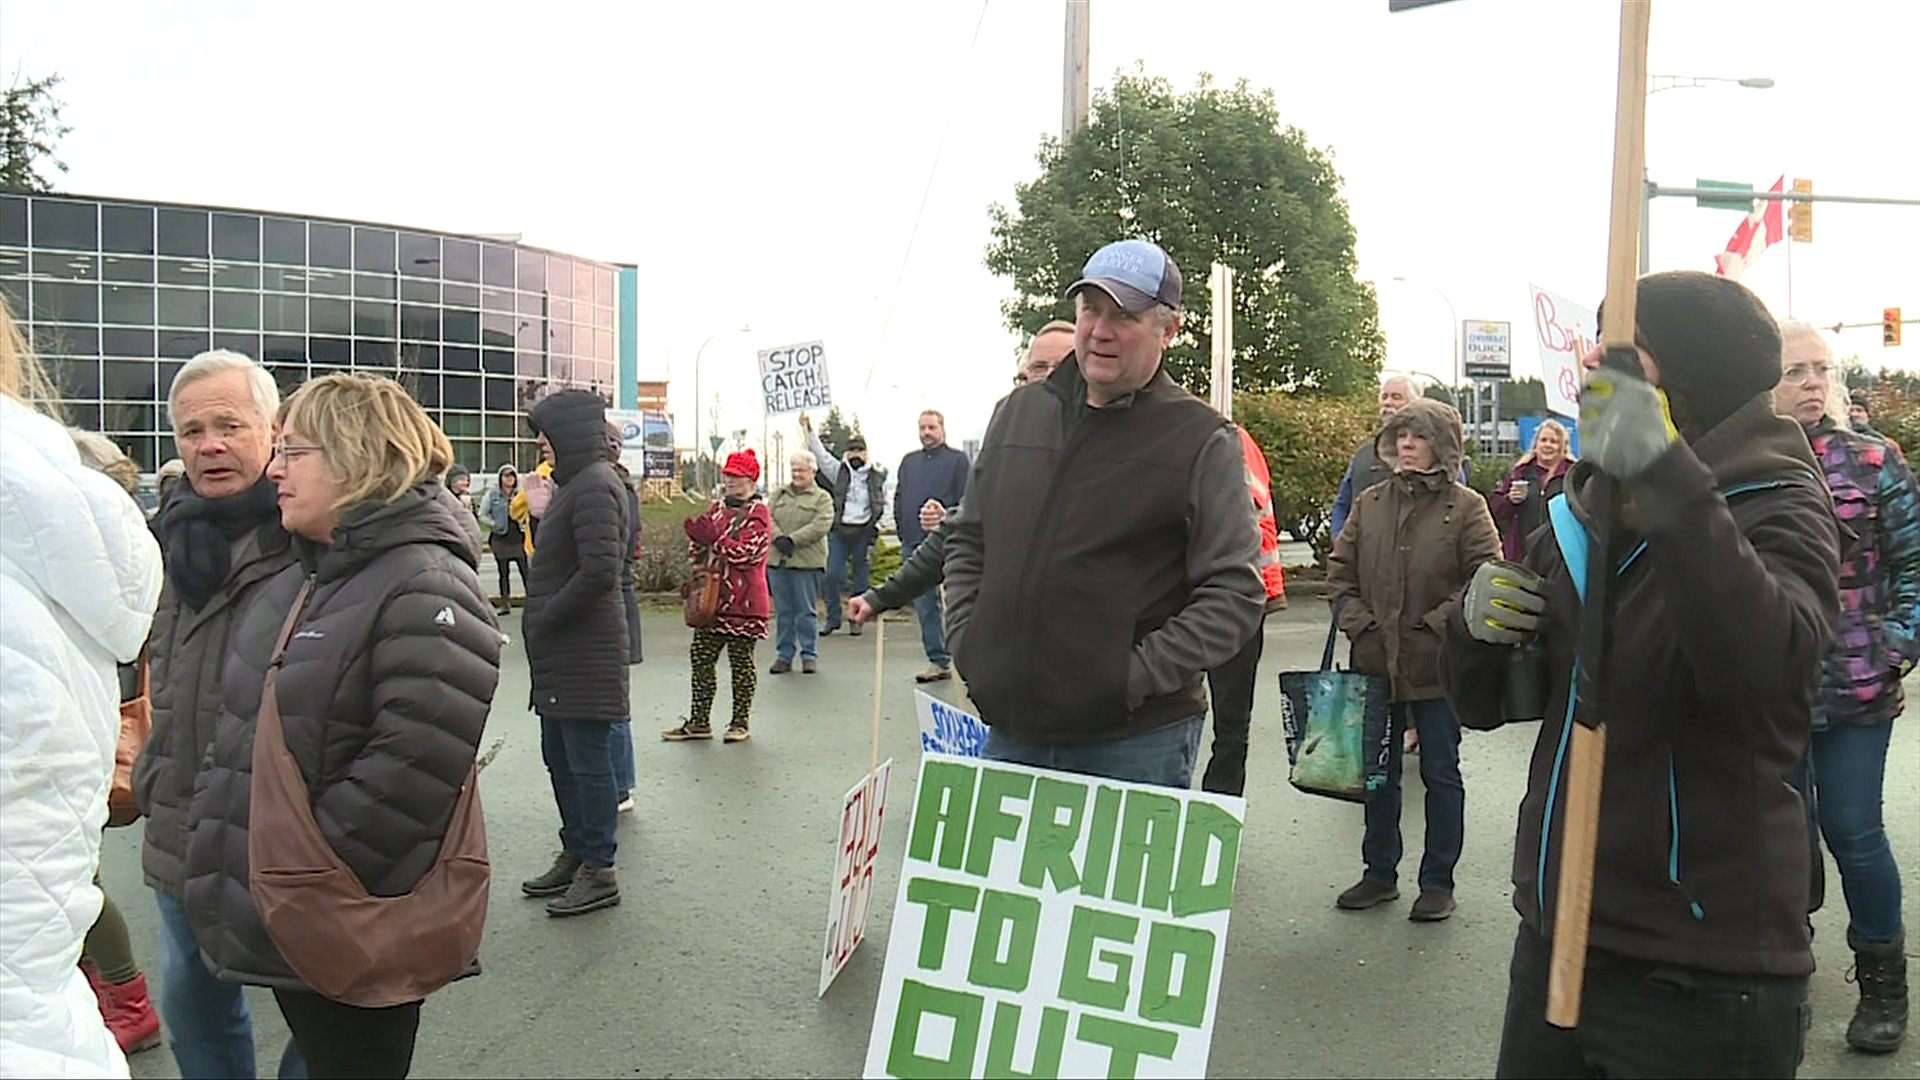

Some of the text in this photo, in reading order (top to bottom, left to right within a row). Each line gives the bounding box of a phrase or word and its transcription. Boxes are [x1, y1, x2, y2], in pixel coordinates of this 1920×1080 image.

[762, 367, 816, 394] CATCH
[769, 344, 823, 372] STOP
[765, 384, 832, 414] RELEASE
[908, 760, 1244, 918] AFRIAD
[906, 876, 1217, 1029] TO GO
[885, 977, 1180, 1080] OUT
